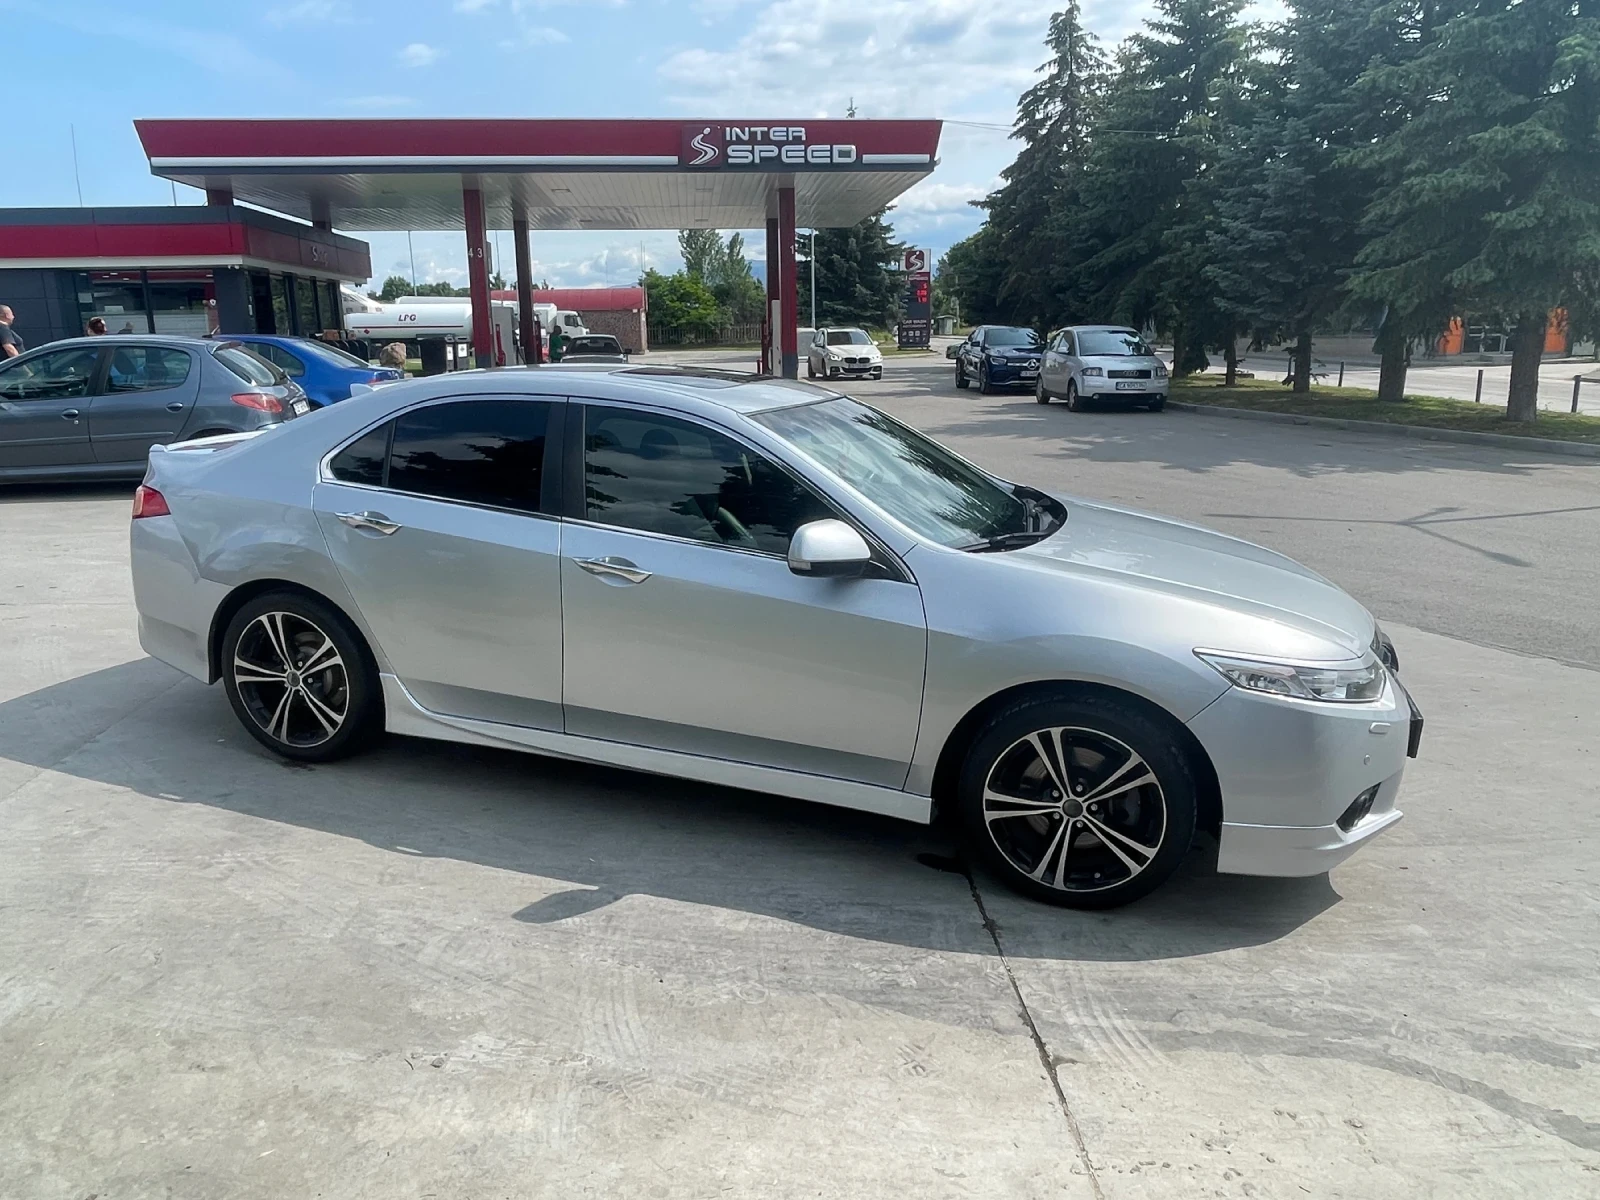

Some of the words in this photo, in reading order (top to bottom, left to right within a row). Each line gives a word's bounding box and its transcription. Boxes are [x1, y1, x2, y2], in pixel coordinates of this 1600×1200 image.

[725, 126, 806, 141] INTER
[726, 144, 857, 164] SPEED
[468, 247, 474, 258] 4
[477, 247, 483, 258] 3
[789, 244, 795, 255] 1
[398, 313, 417, 322] LPG
